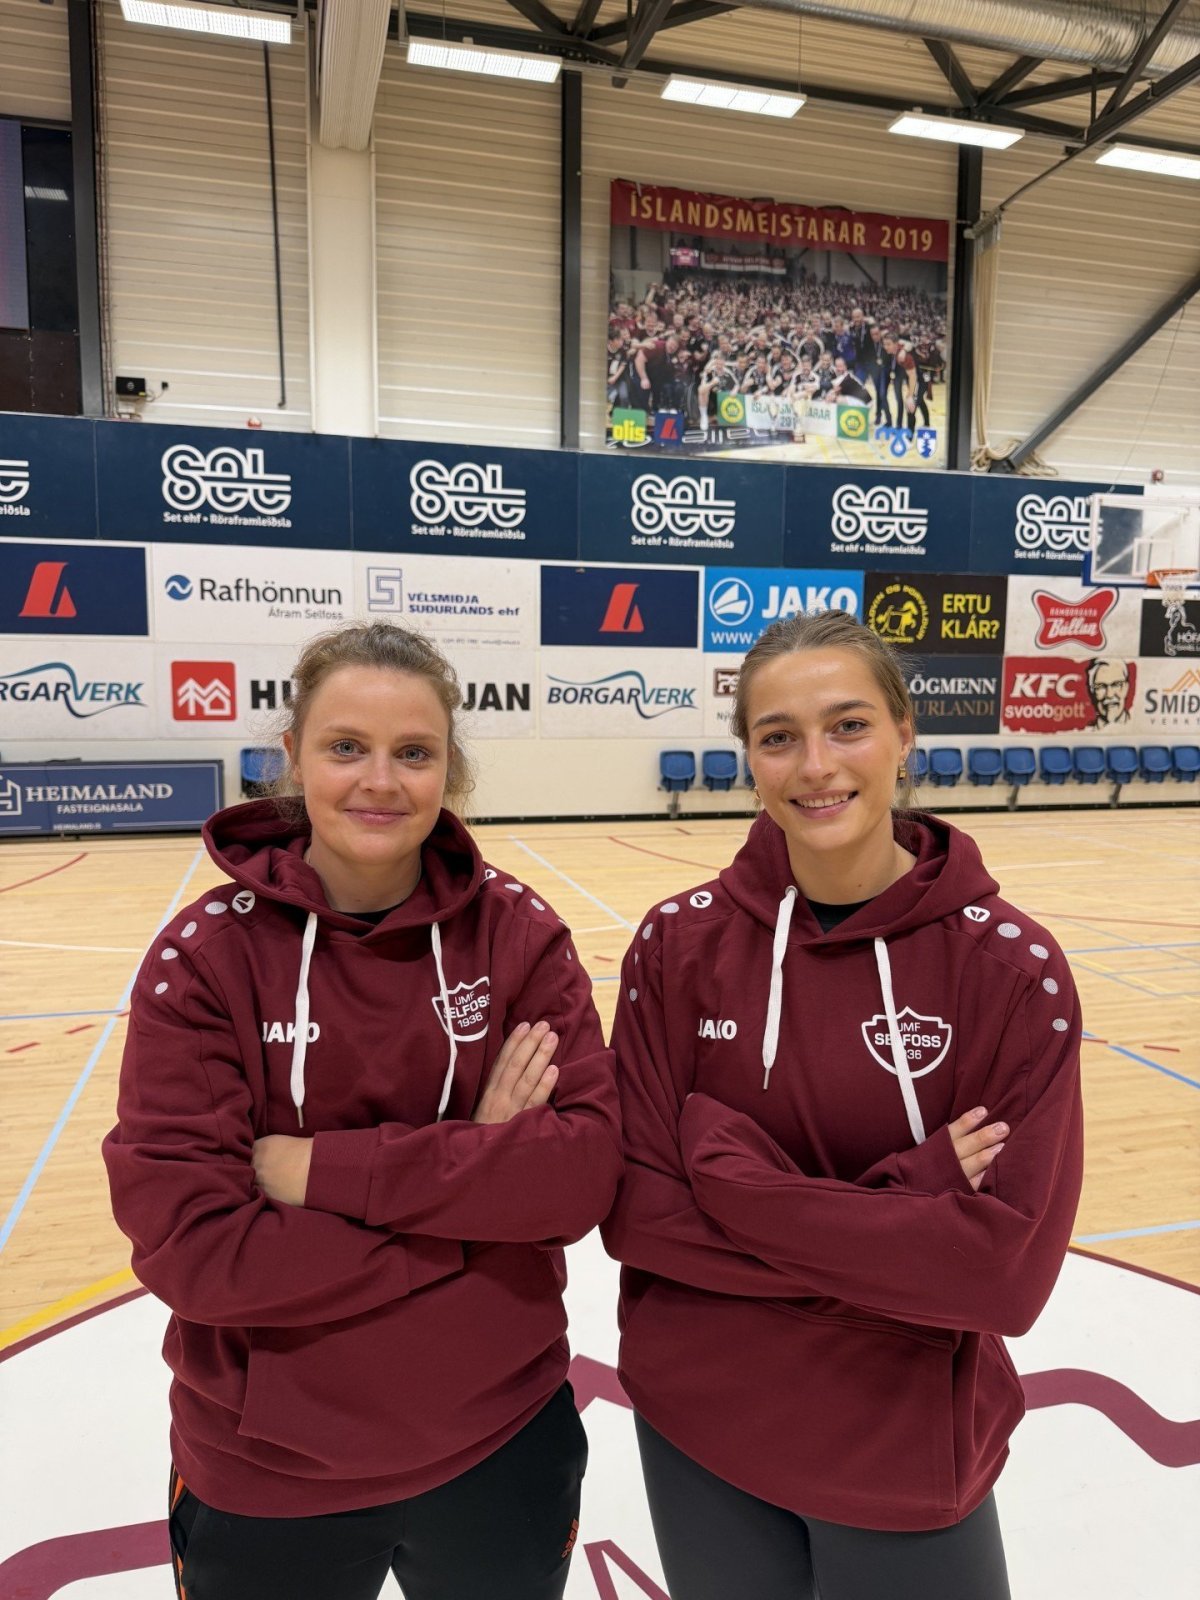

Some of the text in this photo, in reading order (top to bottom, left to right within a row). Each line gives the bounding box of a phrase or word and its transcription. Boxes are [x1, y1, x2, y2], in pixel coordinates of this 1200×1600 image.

[630, 191, 933, 251] ÍSLANDSMEISTARAR 2019
[163, 512, 292, 528] Set ehf Röraframleiðsla
[411, 524, 526, 540] Set ehf Röraframleiðsla
[631, 535, 646, 545] Set
[647, 535, 662, 546] ehf
[831, 543, 844, 552] Set
[845, 543, 859, 552] ehf
[1014, 549, 1027, 558] Set
[200, 577, 342, 606] Rafhönnun
[762, 585, 858, 619] JAKO
[942, 593, 991, 614] ERTU
[305, 607, 343, 620] Selfoss
[498, 607, 520, 616] ehf
[941, 614, 1000, 639] KLÁR?
[907, 674, 997, 695] ÖGMENN
[1010, 673, 1082, 698] KFC
[547, 687, 696, 704] BORGARVERK
[26, 783, 173, 802] HEIMALAND
[57, 803, 143, 814] FASTEIGNASALA
[454, 991, 475, 1006] UMF
[457, 1012, 484, 1029] 1936
[874, 1032, 942, 1048] SEFOSS
